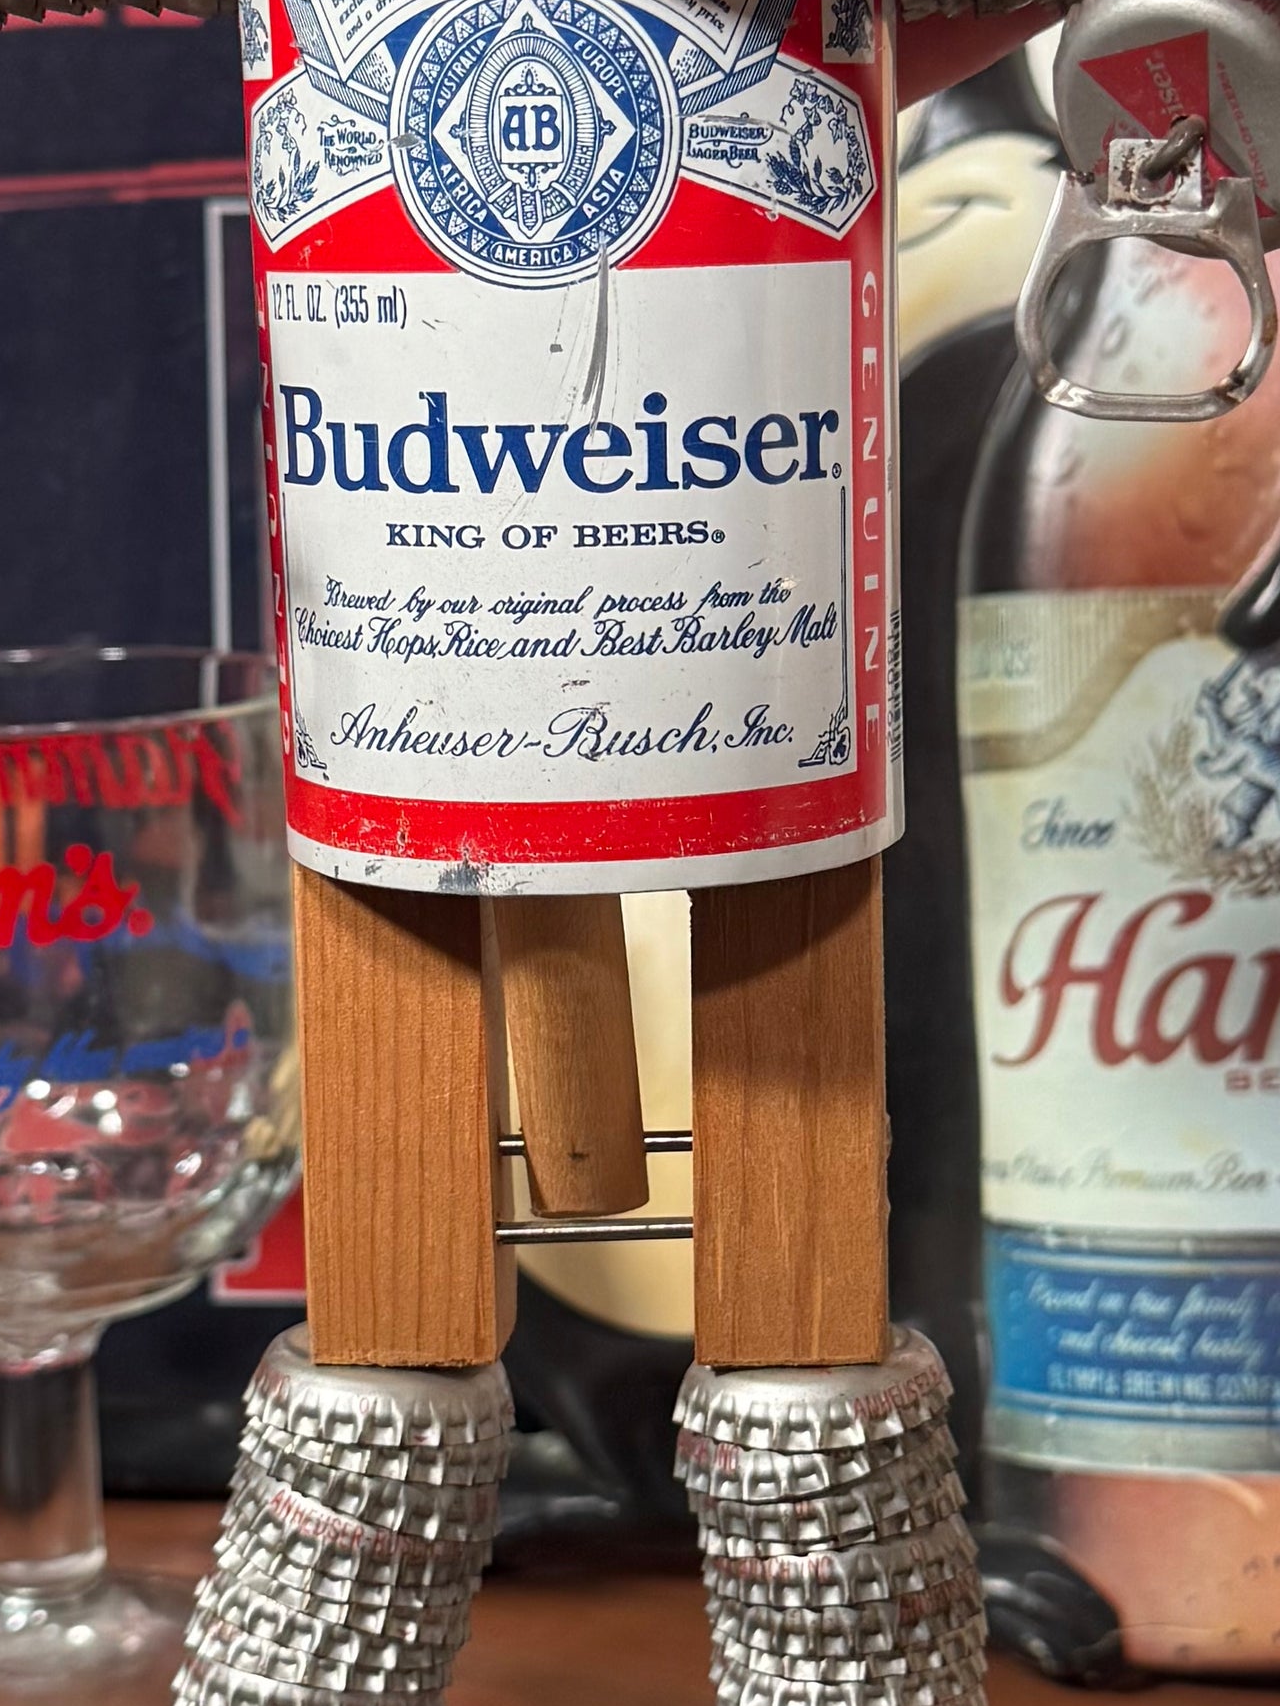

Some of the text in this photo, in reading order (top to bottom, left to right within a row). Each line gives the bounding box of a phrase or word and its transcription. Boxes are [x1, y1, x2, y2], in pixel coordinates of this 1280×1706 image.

[345, 17, 364, 42] and
[365, 11, 373, 22] a
[437, 38, 487, 109] AUSTRALIA
[573, 35, 625, 99] EUROPE
[502, 104, 562, 151] AB
[688, 122, 769, 140] BUDWEISER
[440, 164, 488, 223] AFRICA
[583, 169, 625, 219] ASIA
[492, 247, 574, 268] AMERICA
[272, 284, 408, 329] 12 FL. OZ. (355 ml)
[385, 522, 486, 550] KING
[501, 523, 557, 550] OF
[861, 269, 881, 755] GENUINE
[324, 574, 792, 625] Brewed by our original process from the
[294, 606, 363, 650] Choicest
[500, 629, 581, 659] and
[580, 616, 663, 656] Best
[662, 614, 780, 660] Barley
[775, 600, 837, 647] Malt
[723, 703, 794, 747] Inc.
[1022, 799, 1117, 853] Since
